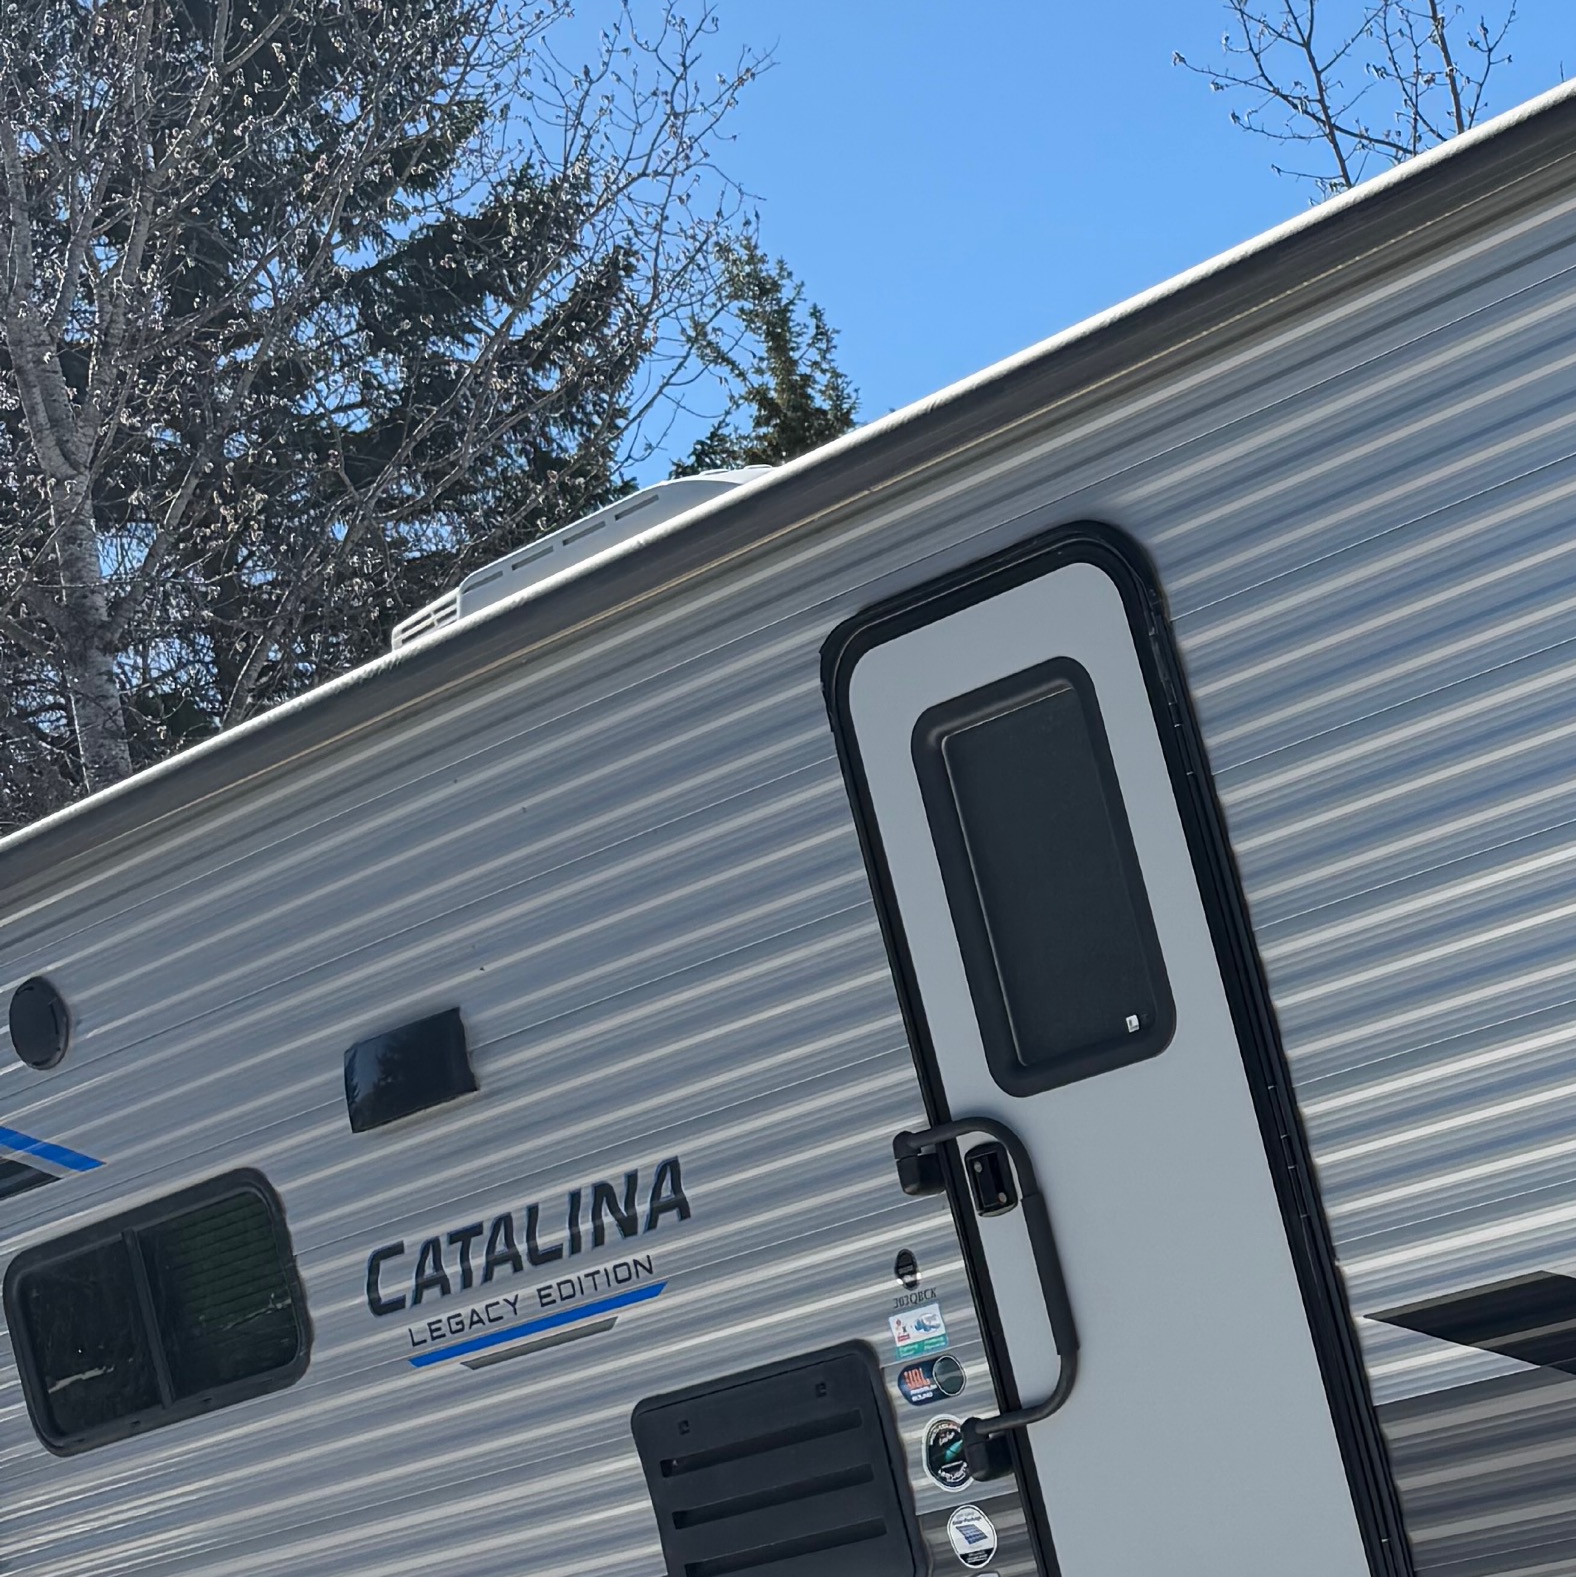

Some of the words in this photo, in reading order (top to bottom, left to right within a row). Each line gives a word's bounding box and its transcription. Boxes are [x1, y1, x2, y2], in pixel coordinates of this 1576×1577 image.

[366, 1155, 692, 1318] CATALINA
[408, 1293, 520, 1347] LEGACY
[537, 1254, 654, 1308] EDITION
